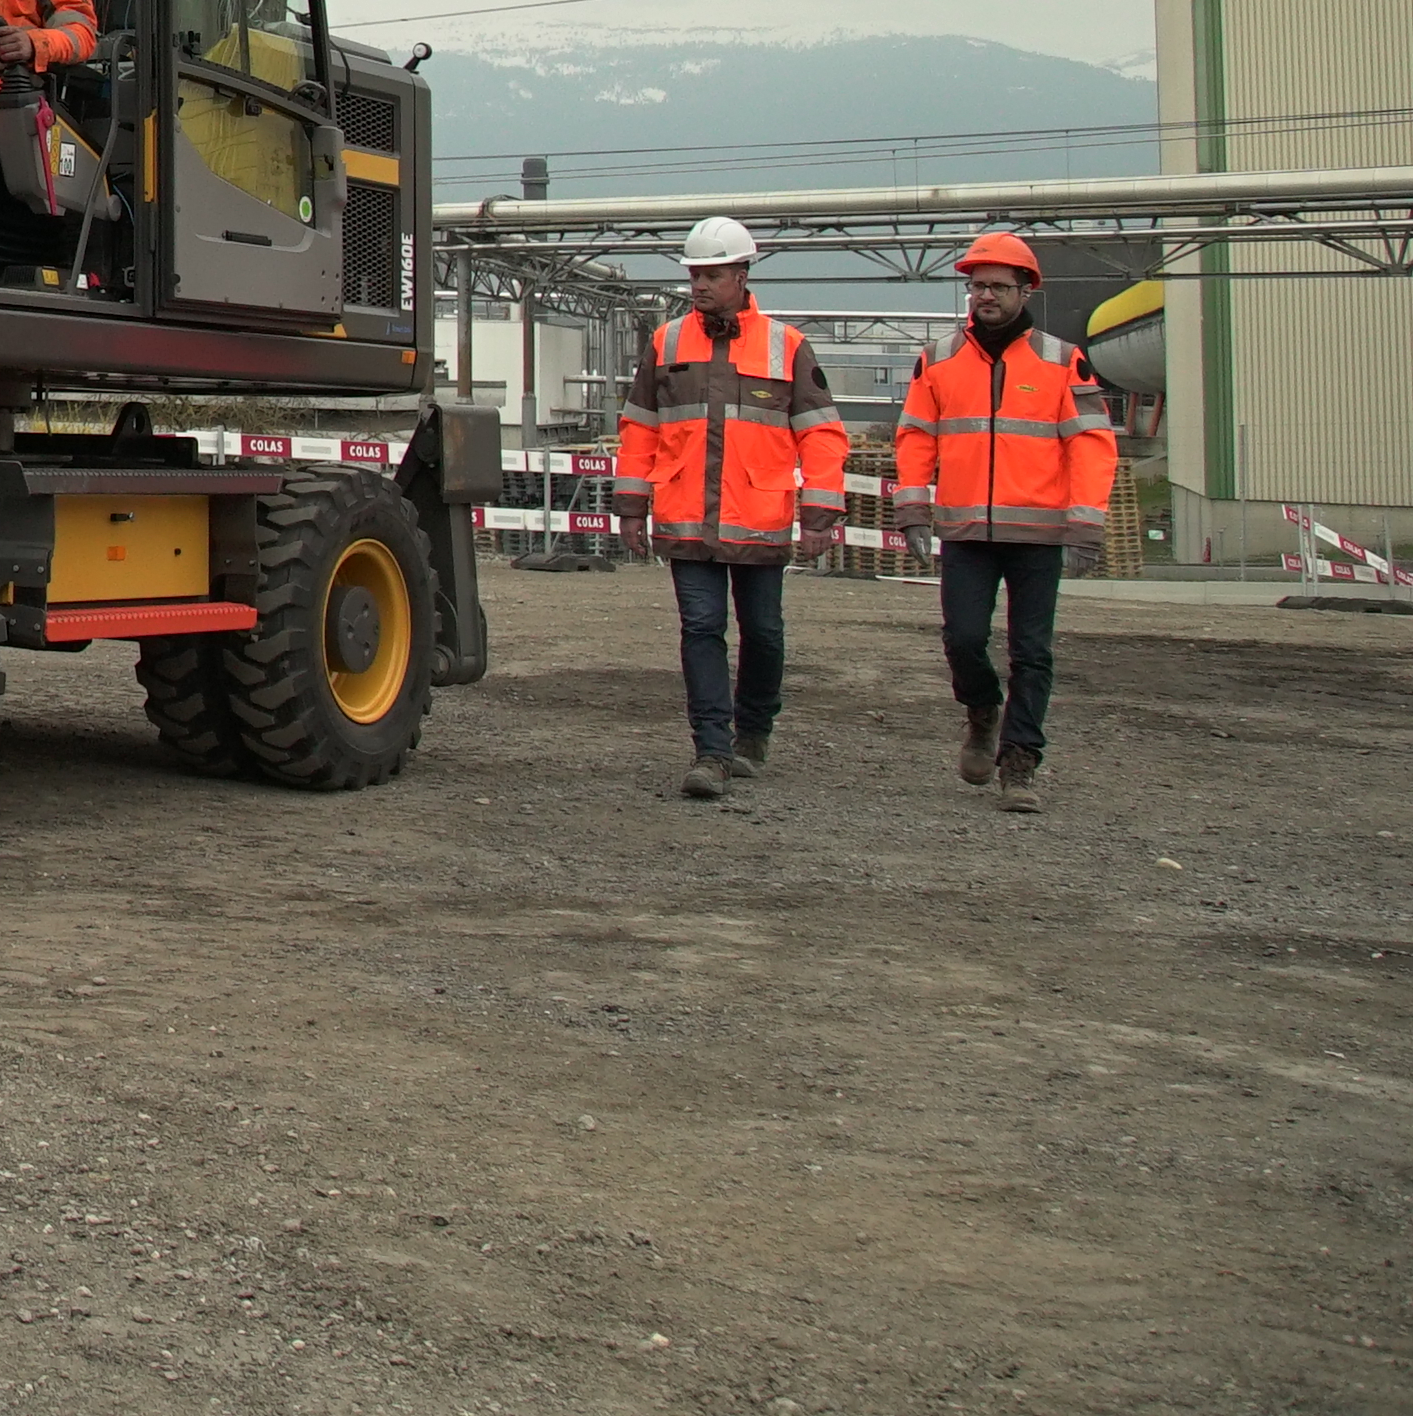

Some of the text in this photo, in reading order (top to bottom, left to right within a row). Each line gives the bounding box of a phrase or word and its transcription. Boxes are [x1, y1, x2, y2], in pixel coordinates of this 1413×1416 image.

[400, 232, 414, 311] EW160E
[250, 439, 284, 453] COLAS
[349, 445, 381, 459] COLAS
[578, 458, 606, 471] COLAS
[576, 516, 604, 529] COLAS
[1343, 541, 1363, 557] COLAS
[1334, 565, 1352, 576] COLAS
